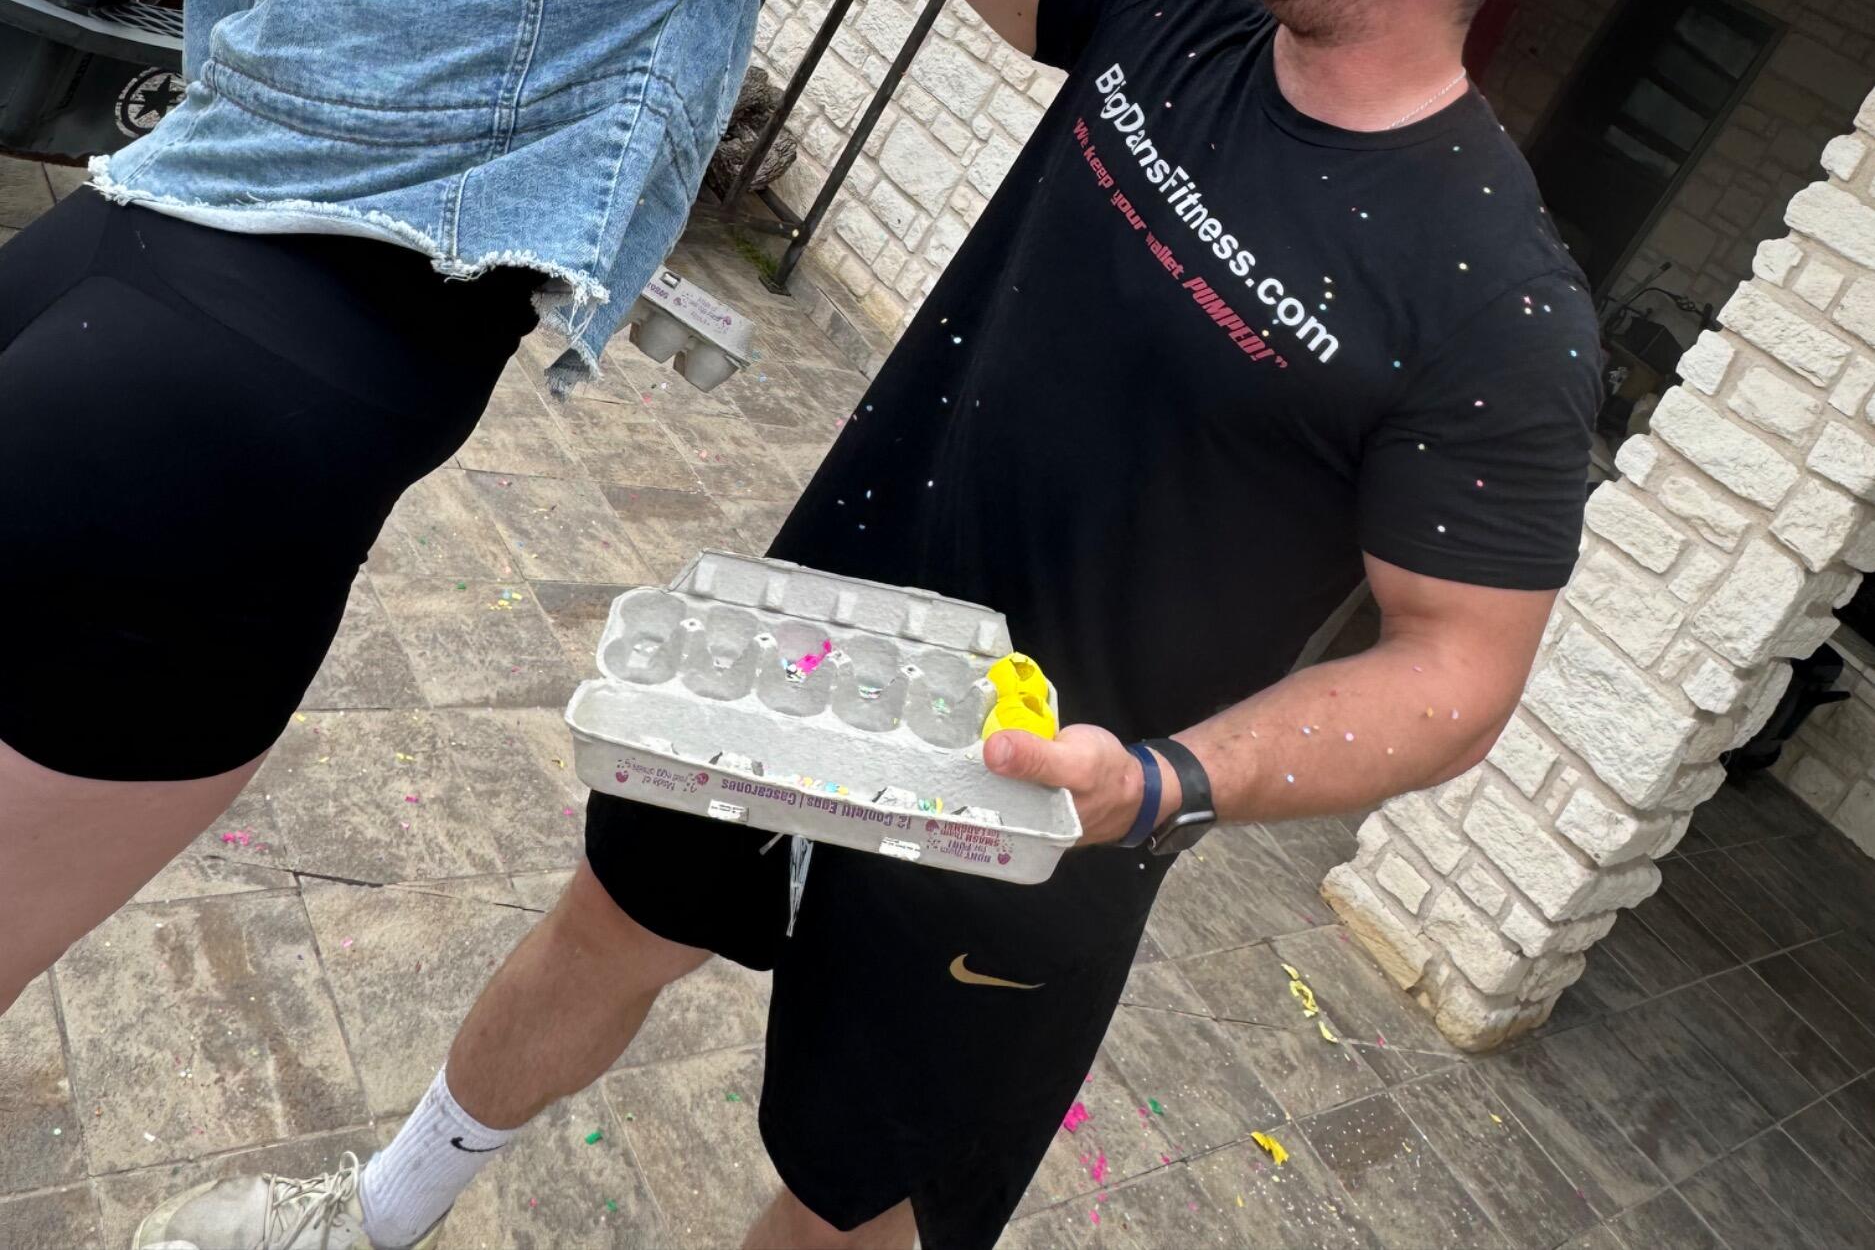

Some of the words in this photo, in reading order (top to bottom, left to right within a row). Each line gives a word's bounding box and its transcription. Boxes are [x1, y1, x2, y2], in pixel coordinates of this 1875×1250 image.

[1083, 145, 1114, 188] keep
[1110, 189, 1147, 230] your
[1095, 63, 1339, 363] BigDansFitness.com
[721, 778, 797, 805] Cascarones
[807, 796, 838, 814] Eggs
[842, 803, 893, 826] Confetti
